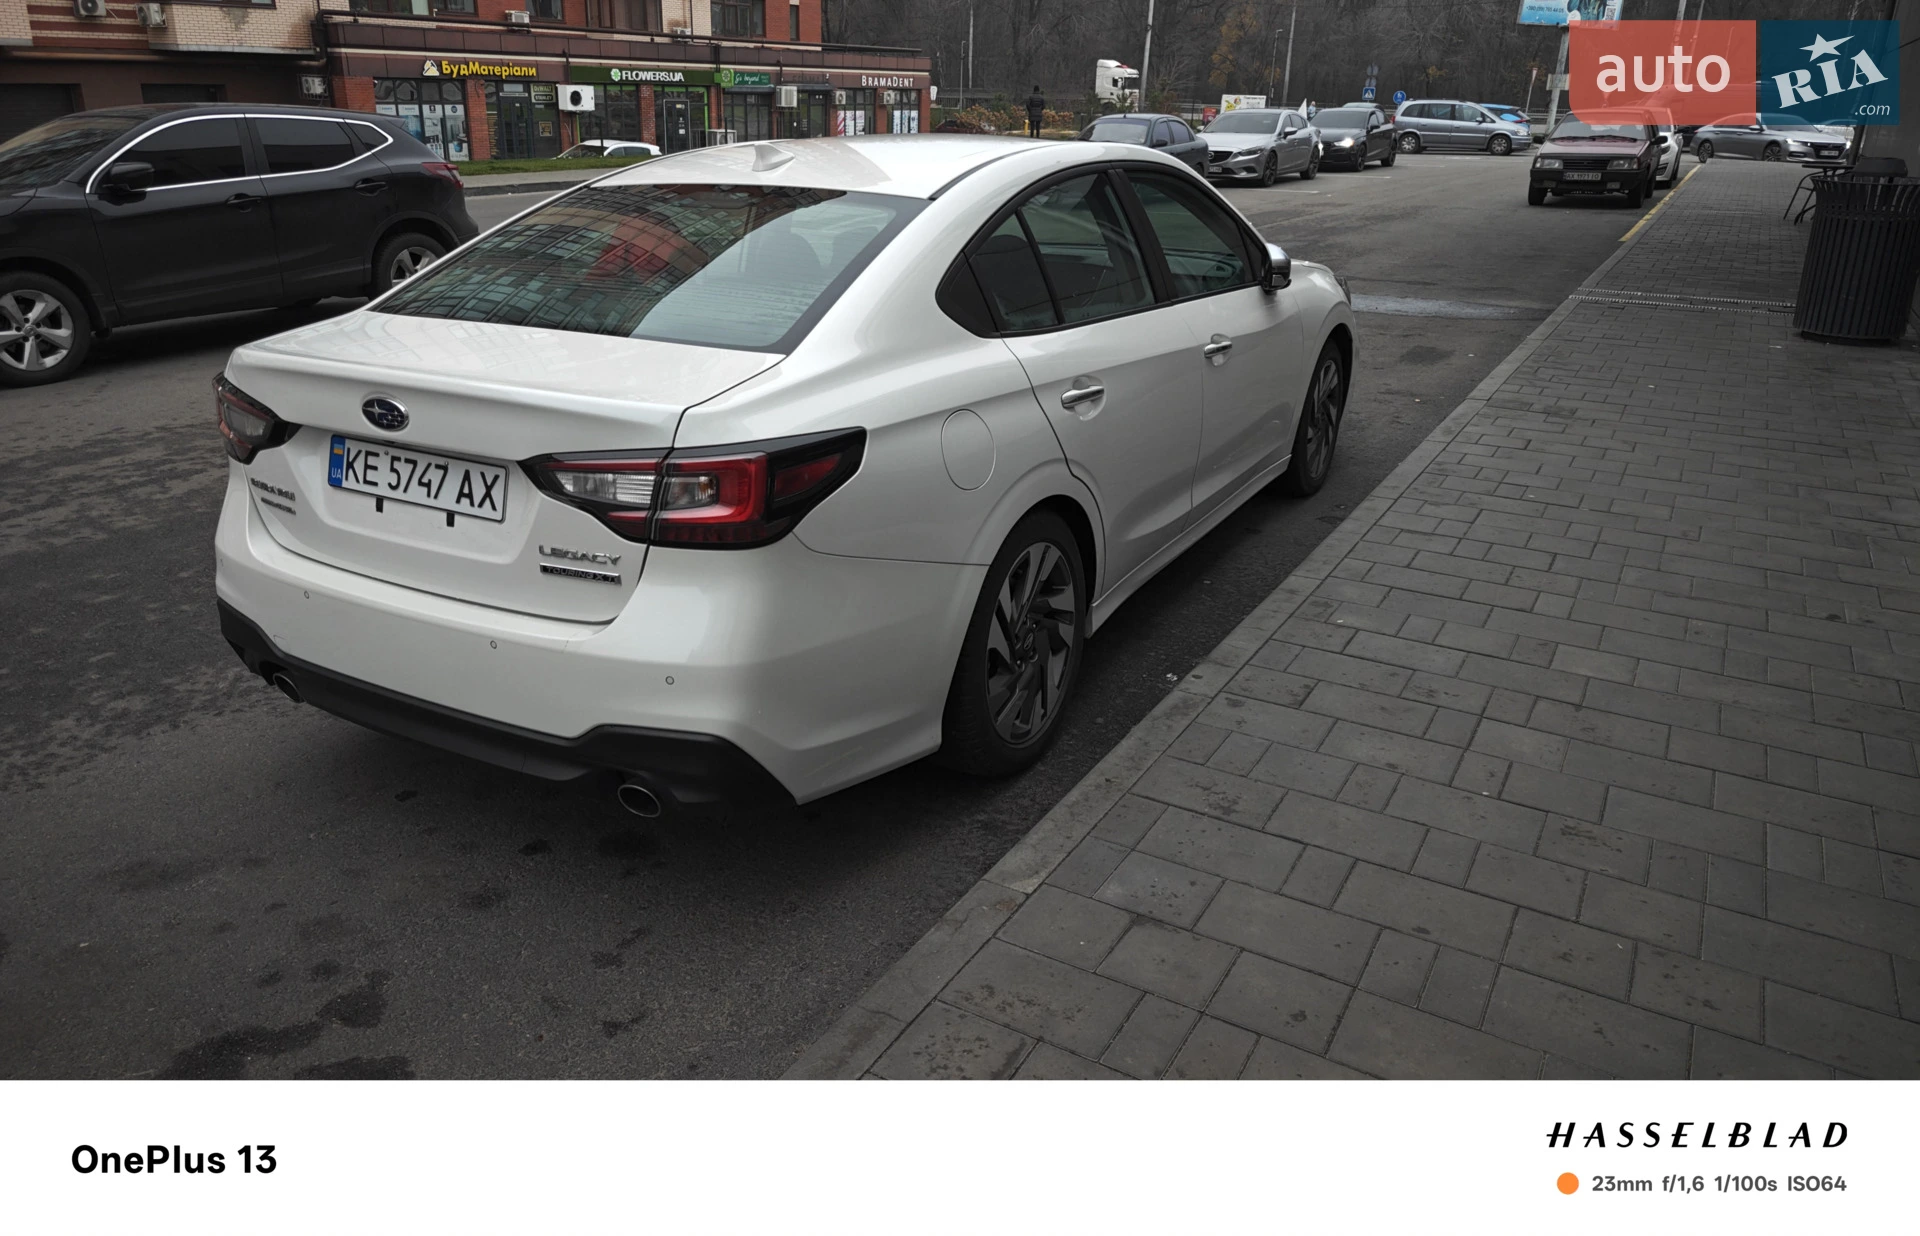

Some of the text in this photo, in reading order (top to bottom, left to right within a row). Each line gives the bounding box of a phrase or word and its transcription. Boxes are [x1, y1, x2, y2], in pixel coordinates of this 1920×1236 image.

[441, 60, 537, 79] БудМатеріали
[622, 70, 685, 82] FLOWERS.UA
[331, 467, 342, 479] UA
[345, 447, 500, 512] KE 5747 AX
[538, 545, 622, 566] LEGACY
